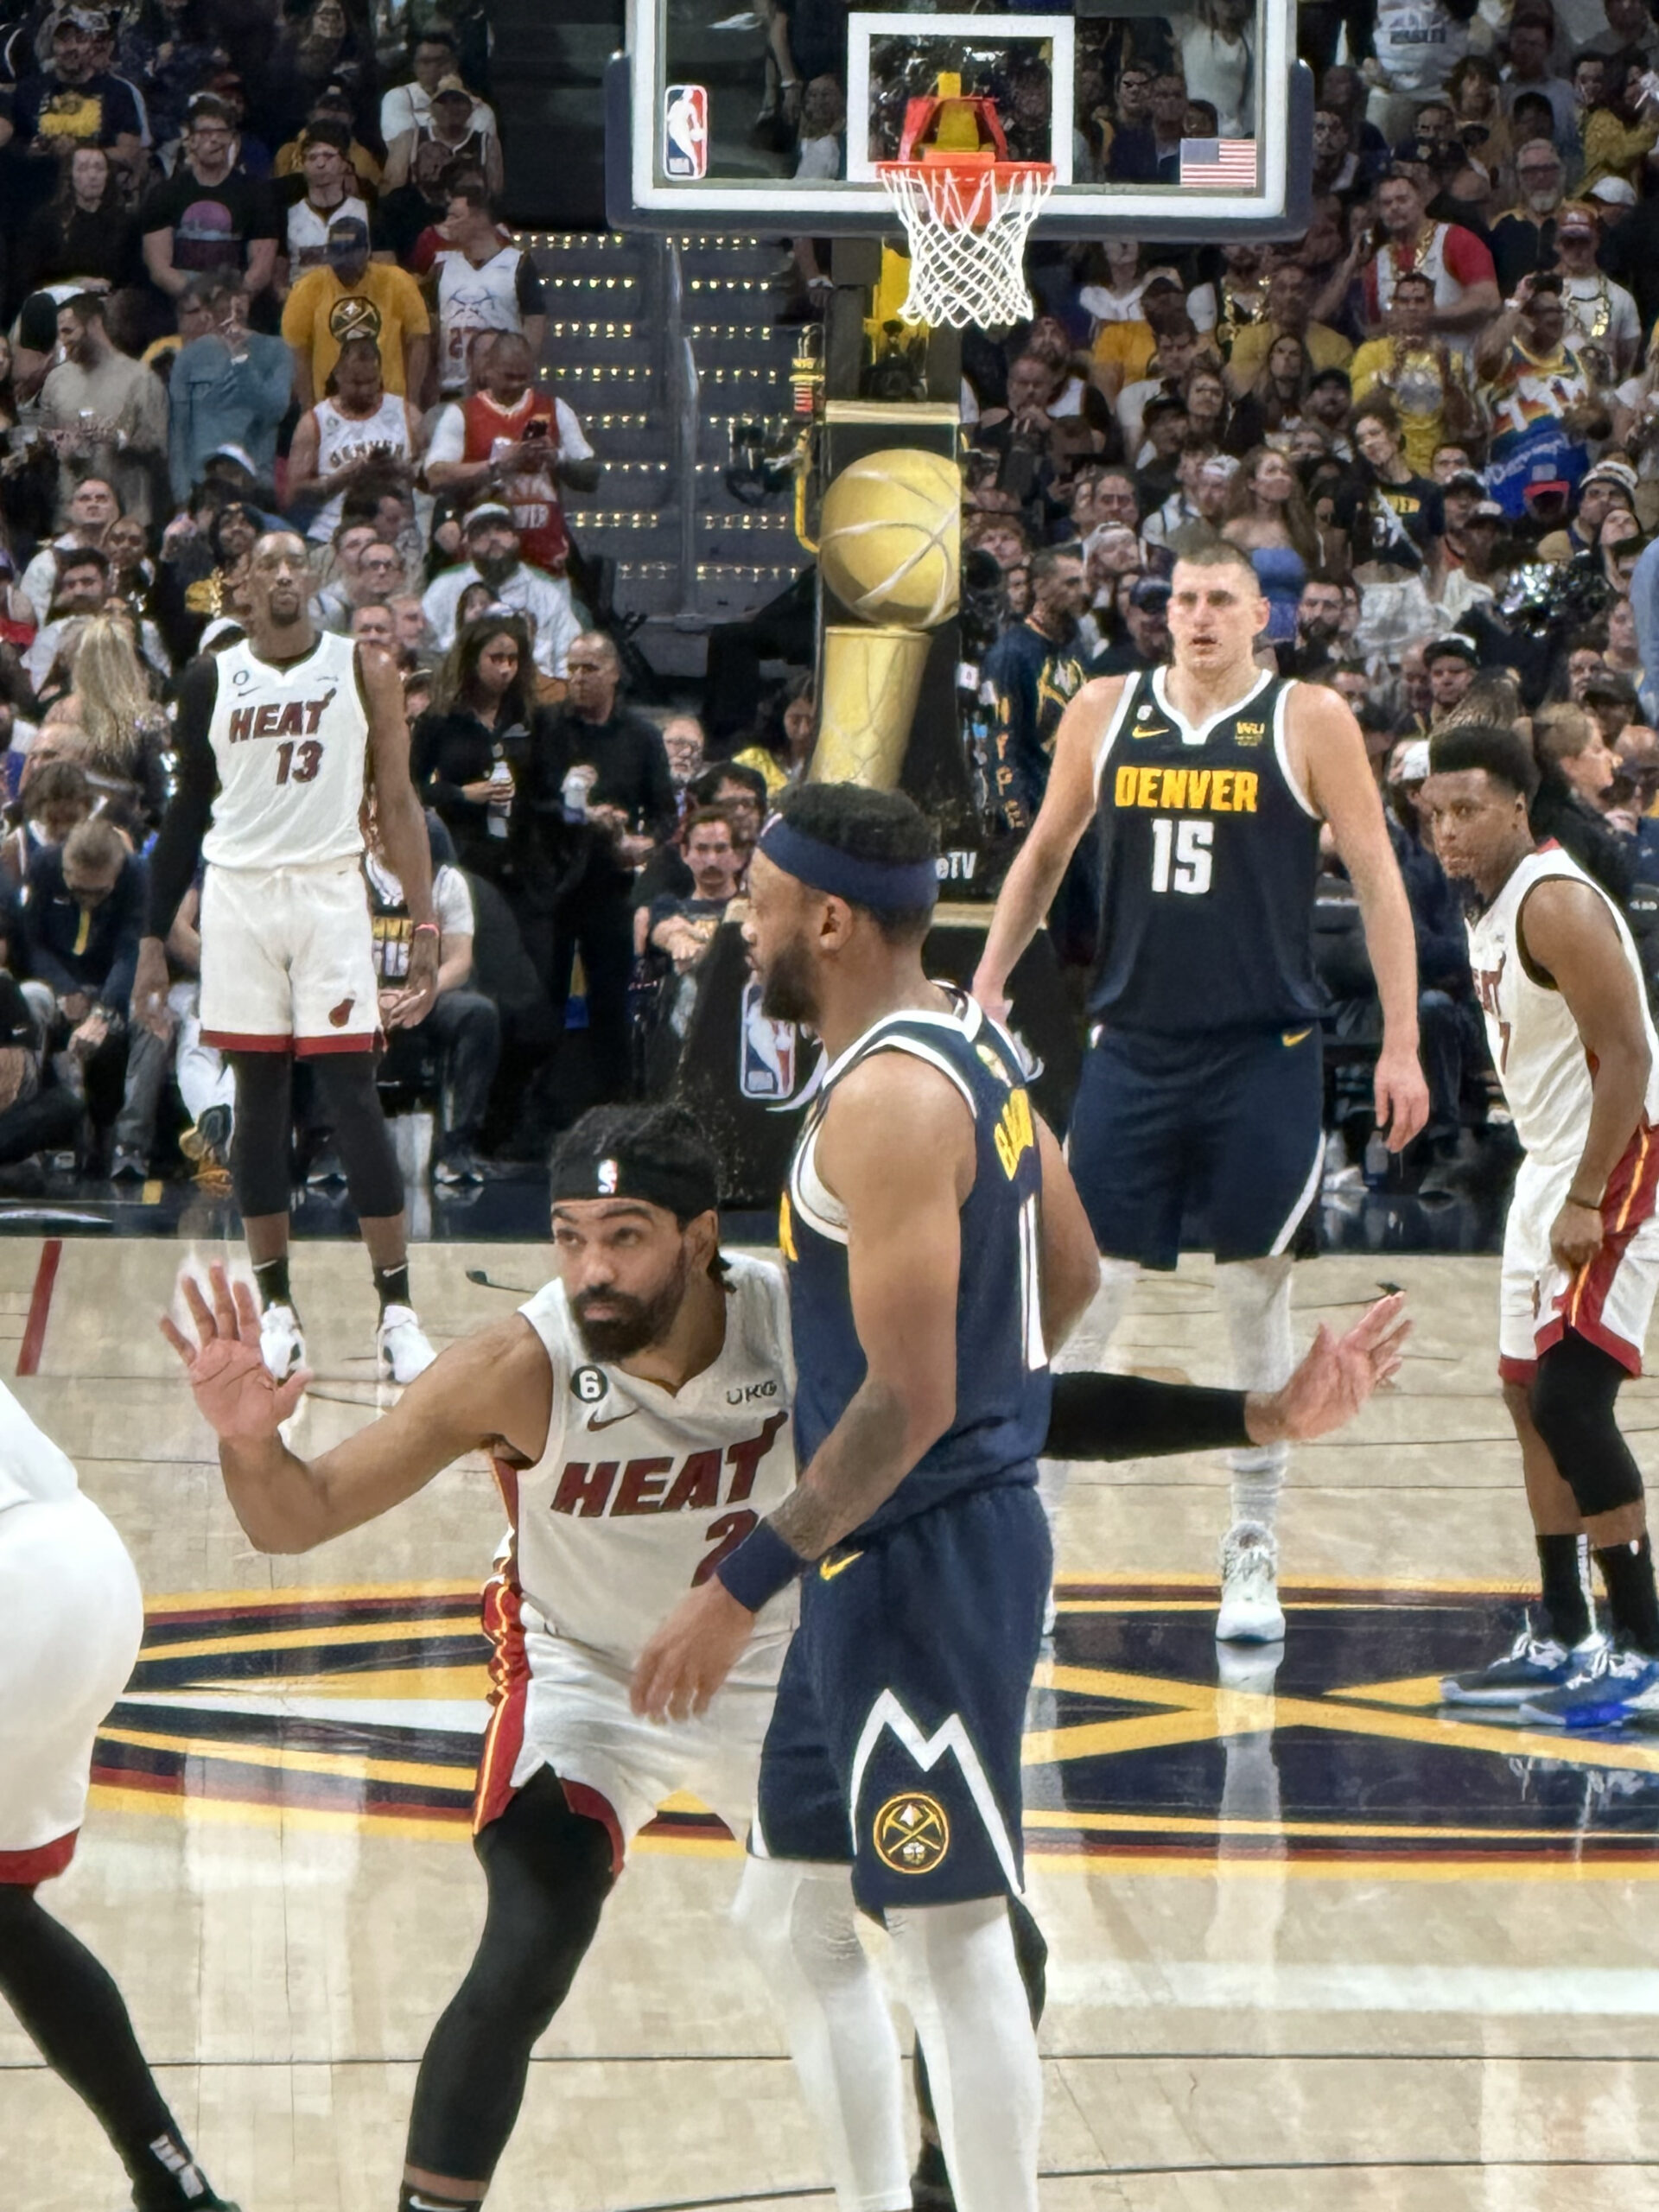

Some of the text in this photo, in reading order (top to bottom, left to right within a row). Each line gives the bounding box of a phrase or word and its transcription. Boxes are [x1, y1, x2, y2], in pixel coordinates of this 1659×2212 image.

[229, 687, 337, 743] HEAT
[276, 741, 323, 785] 13
[1115, 766, 1258, 812] DENVER
[1151, 818, 1214, 894] 15
[578, 1370, 600, 1399] 6
[550, 1411, 789, 1518] HEAT
[690, 1509, 760, 1588] 2
